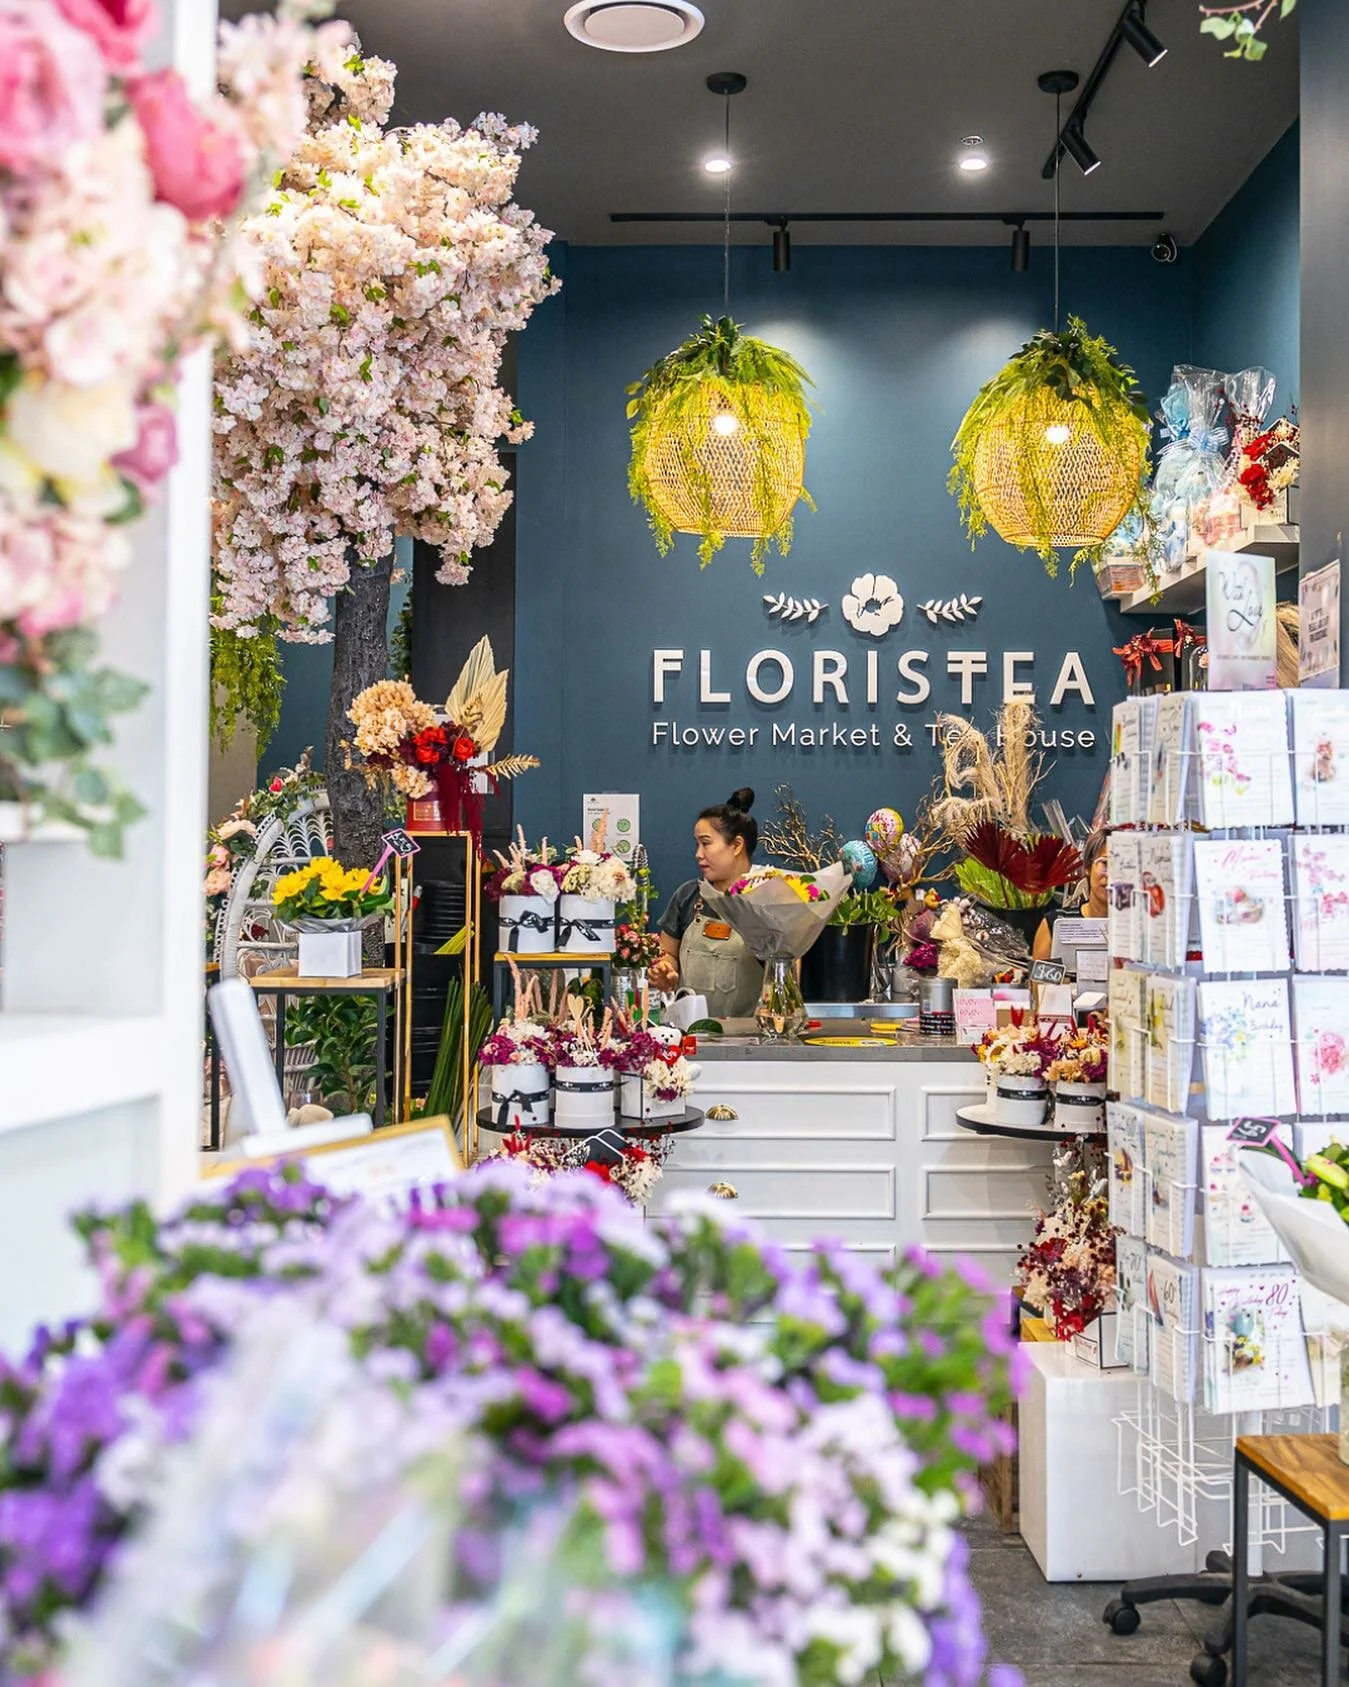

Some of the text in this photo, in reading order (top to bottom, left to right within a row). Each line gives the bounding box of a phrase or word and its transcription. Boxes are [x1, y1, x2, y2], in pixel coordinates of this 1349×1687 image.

[653, 648, 1096, 705] FLORISTEA
[652, 721, 760, 747] Flower
[771, 722, 881, 747] Market
[893, 723, 913, 747] &
[924, 723, 972, 748] Te
[1265, 1282, 1290, 1307] 80
